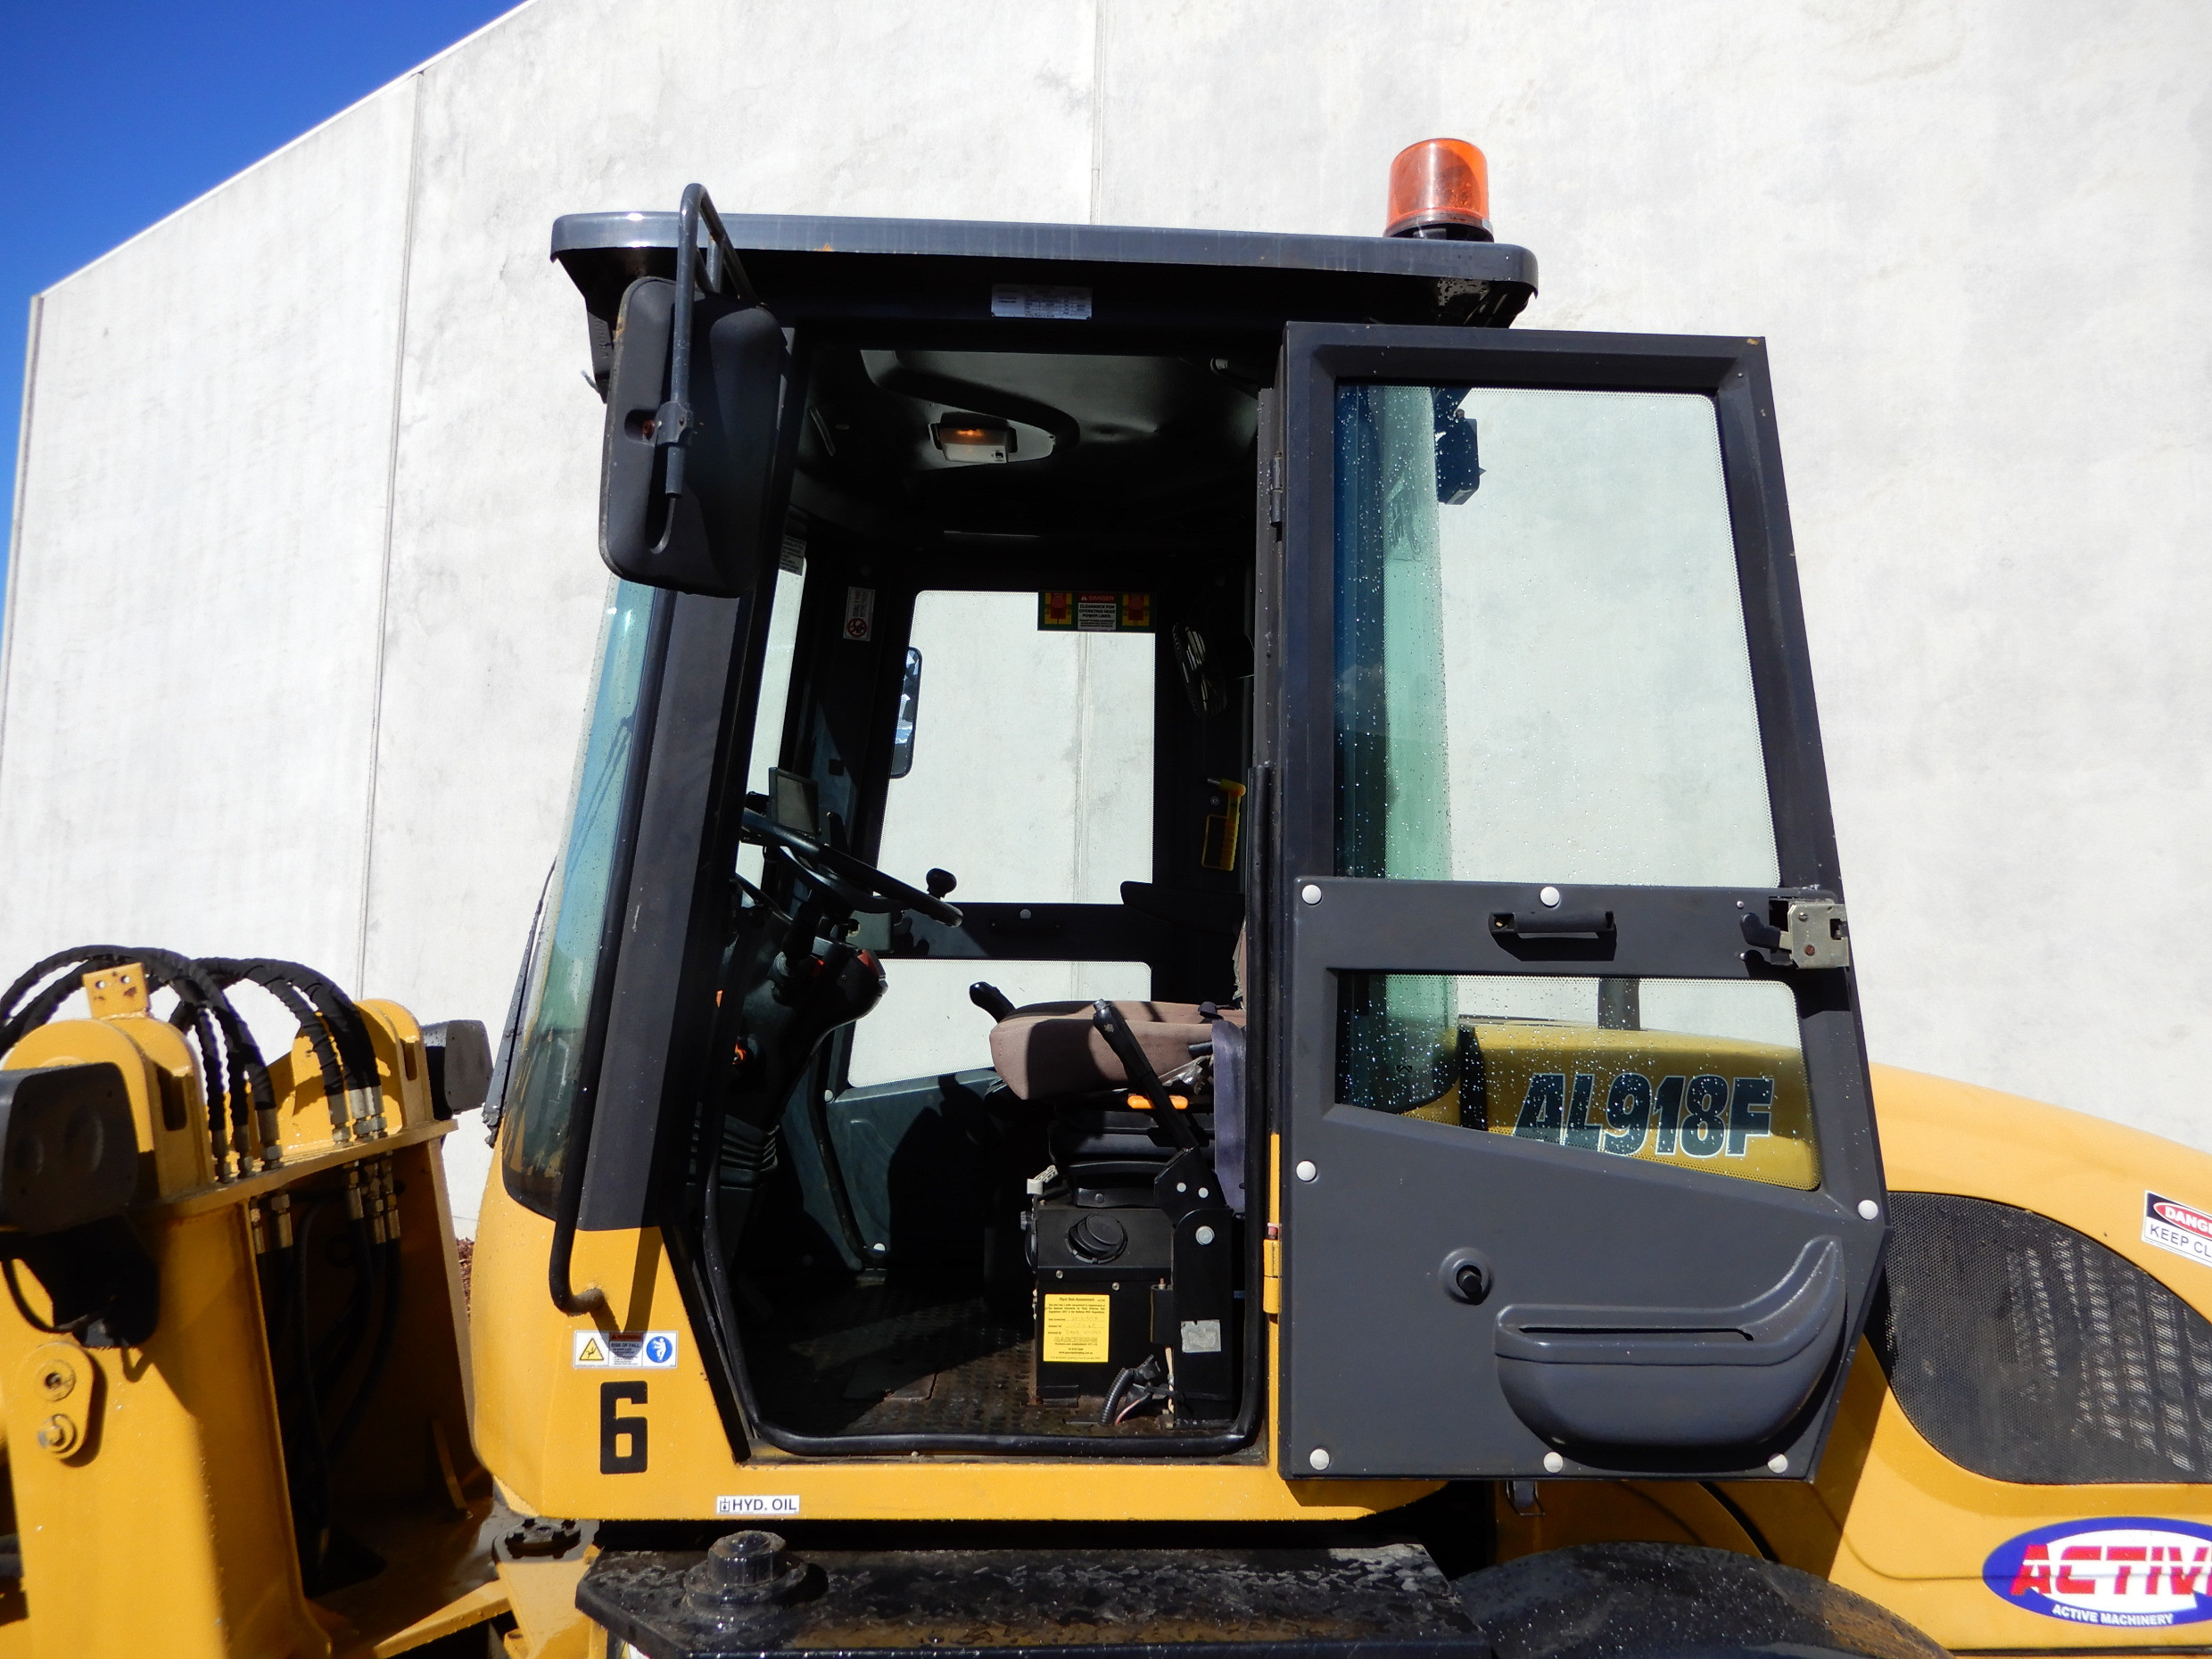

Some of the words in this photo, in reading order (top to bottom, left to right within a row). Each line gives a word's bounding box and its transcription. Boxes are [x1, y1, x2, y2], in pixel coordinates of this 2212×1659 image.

[1512, 1072, 1775, 1159] AL918F
[2150, 1224, 2189, 1247] KEEP
[600, 1380, 648, 1475] 6
[732, 1498, 768, 1511] HYD.
[772, 1498, 797, 1511] OIL
[2010, 1544, 2212, 1597] ACTIV
[2051, 1603, 2099, 1624] ACTIVE
[2100, 1613, 2175, 1627] MACHINERY
